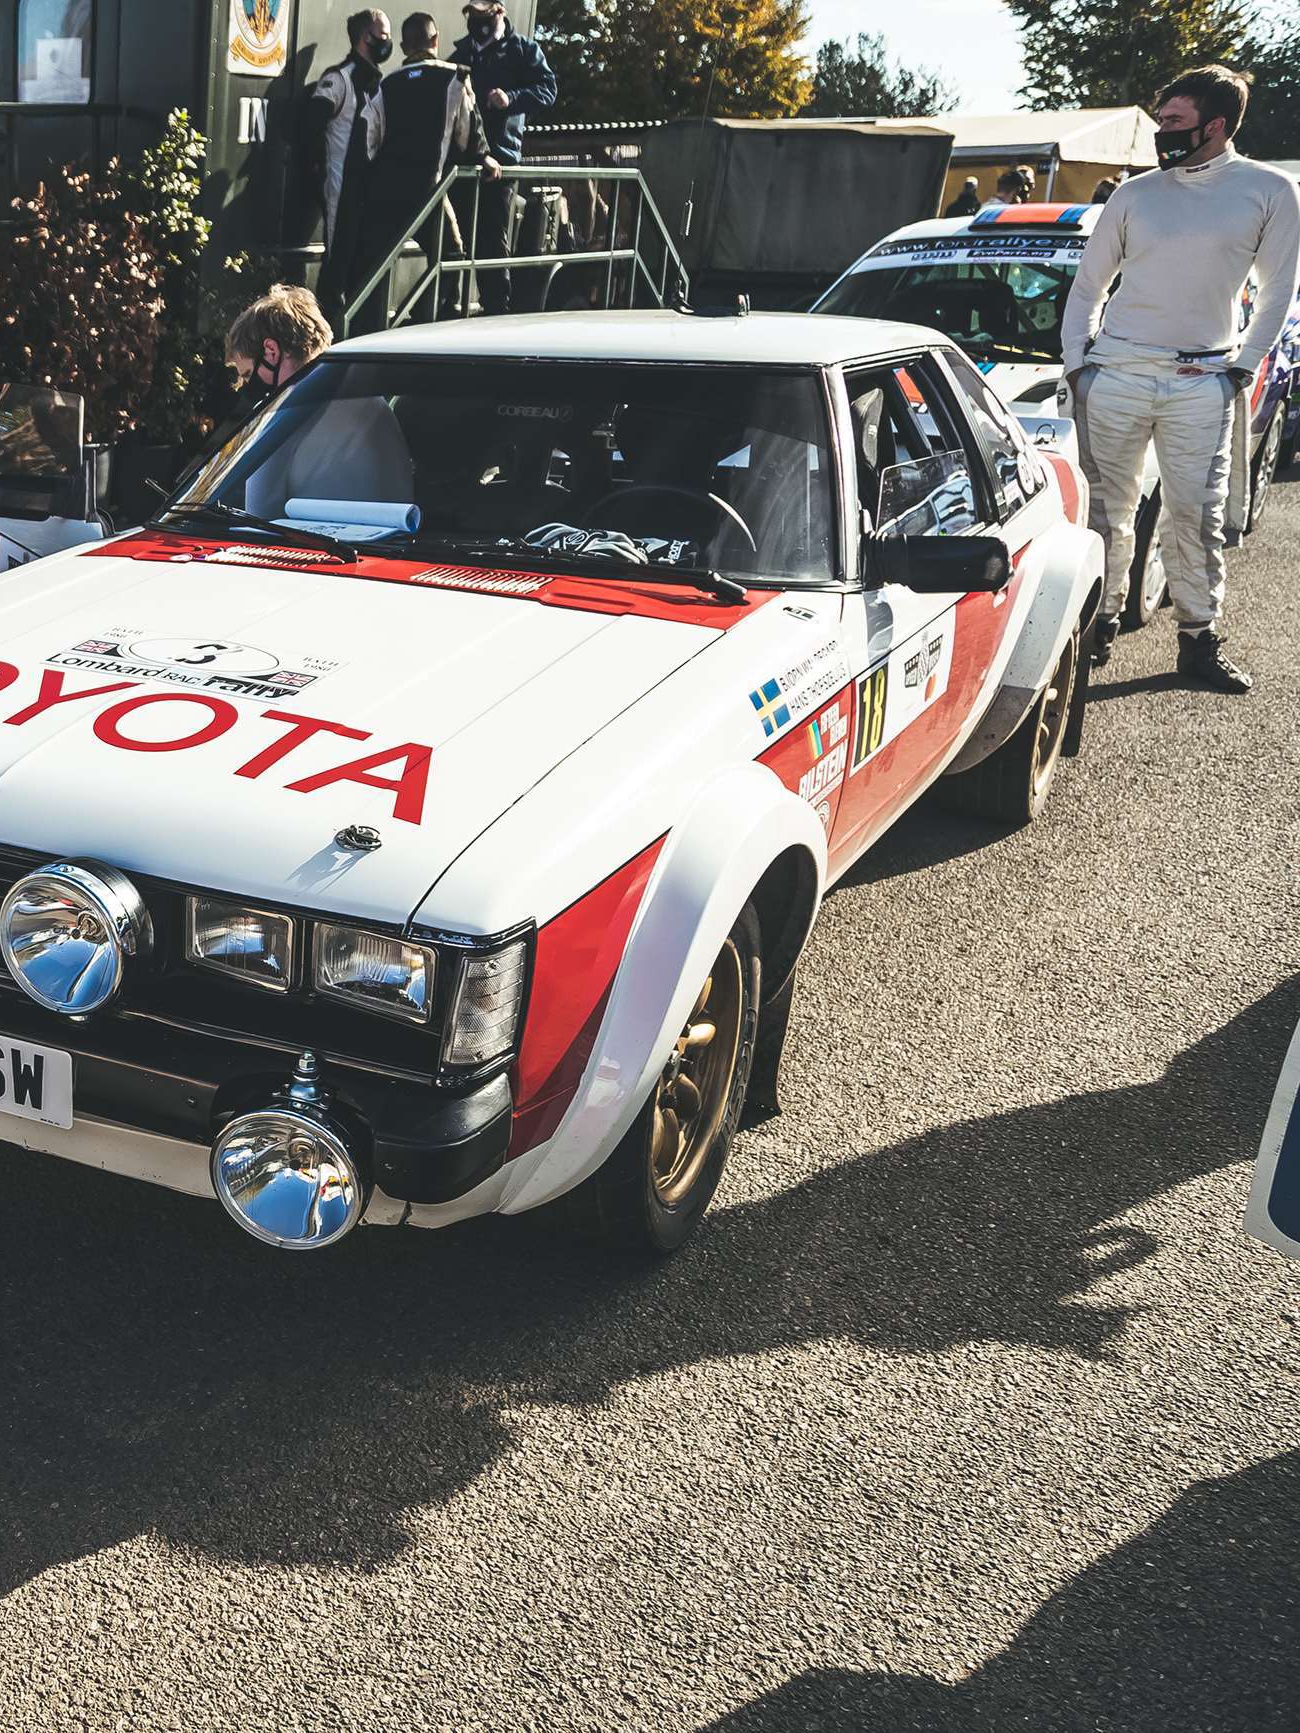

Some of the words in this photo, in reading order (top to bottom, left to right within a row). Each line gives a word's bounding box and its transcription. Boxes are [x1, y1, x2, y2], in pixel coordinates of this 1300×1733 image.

[238, 97, 268, 143] IN
[45, 653, 165, 678] Lombard
[163, 672, 201, 685] RAC
[203, 675, 299, 699] rally
[174, 643, 229, 664] 3
[859, 668, 886, 761] 18
